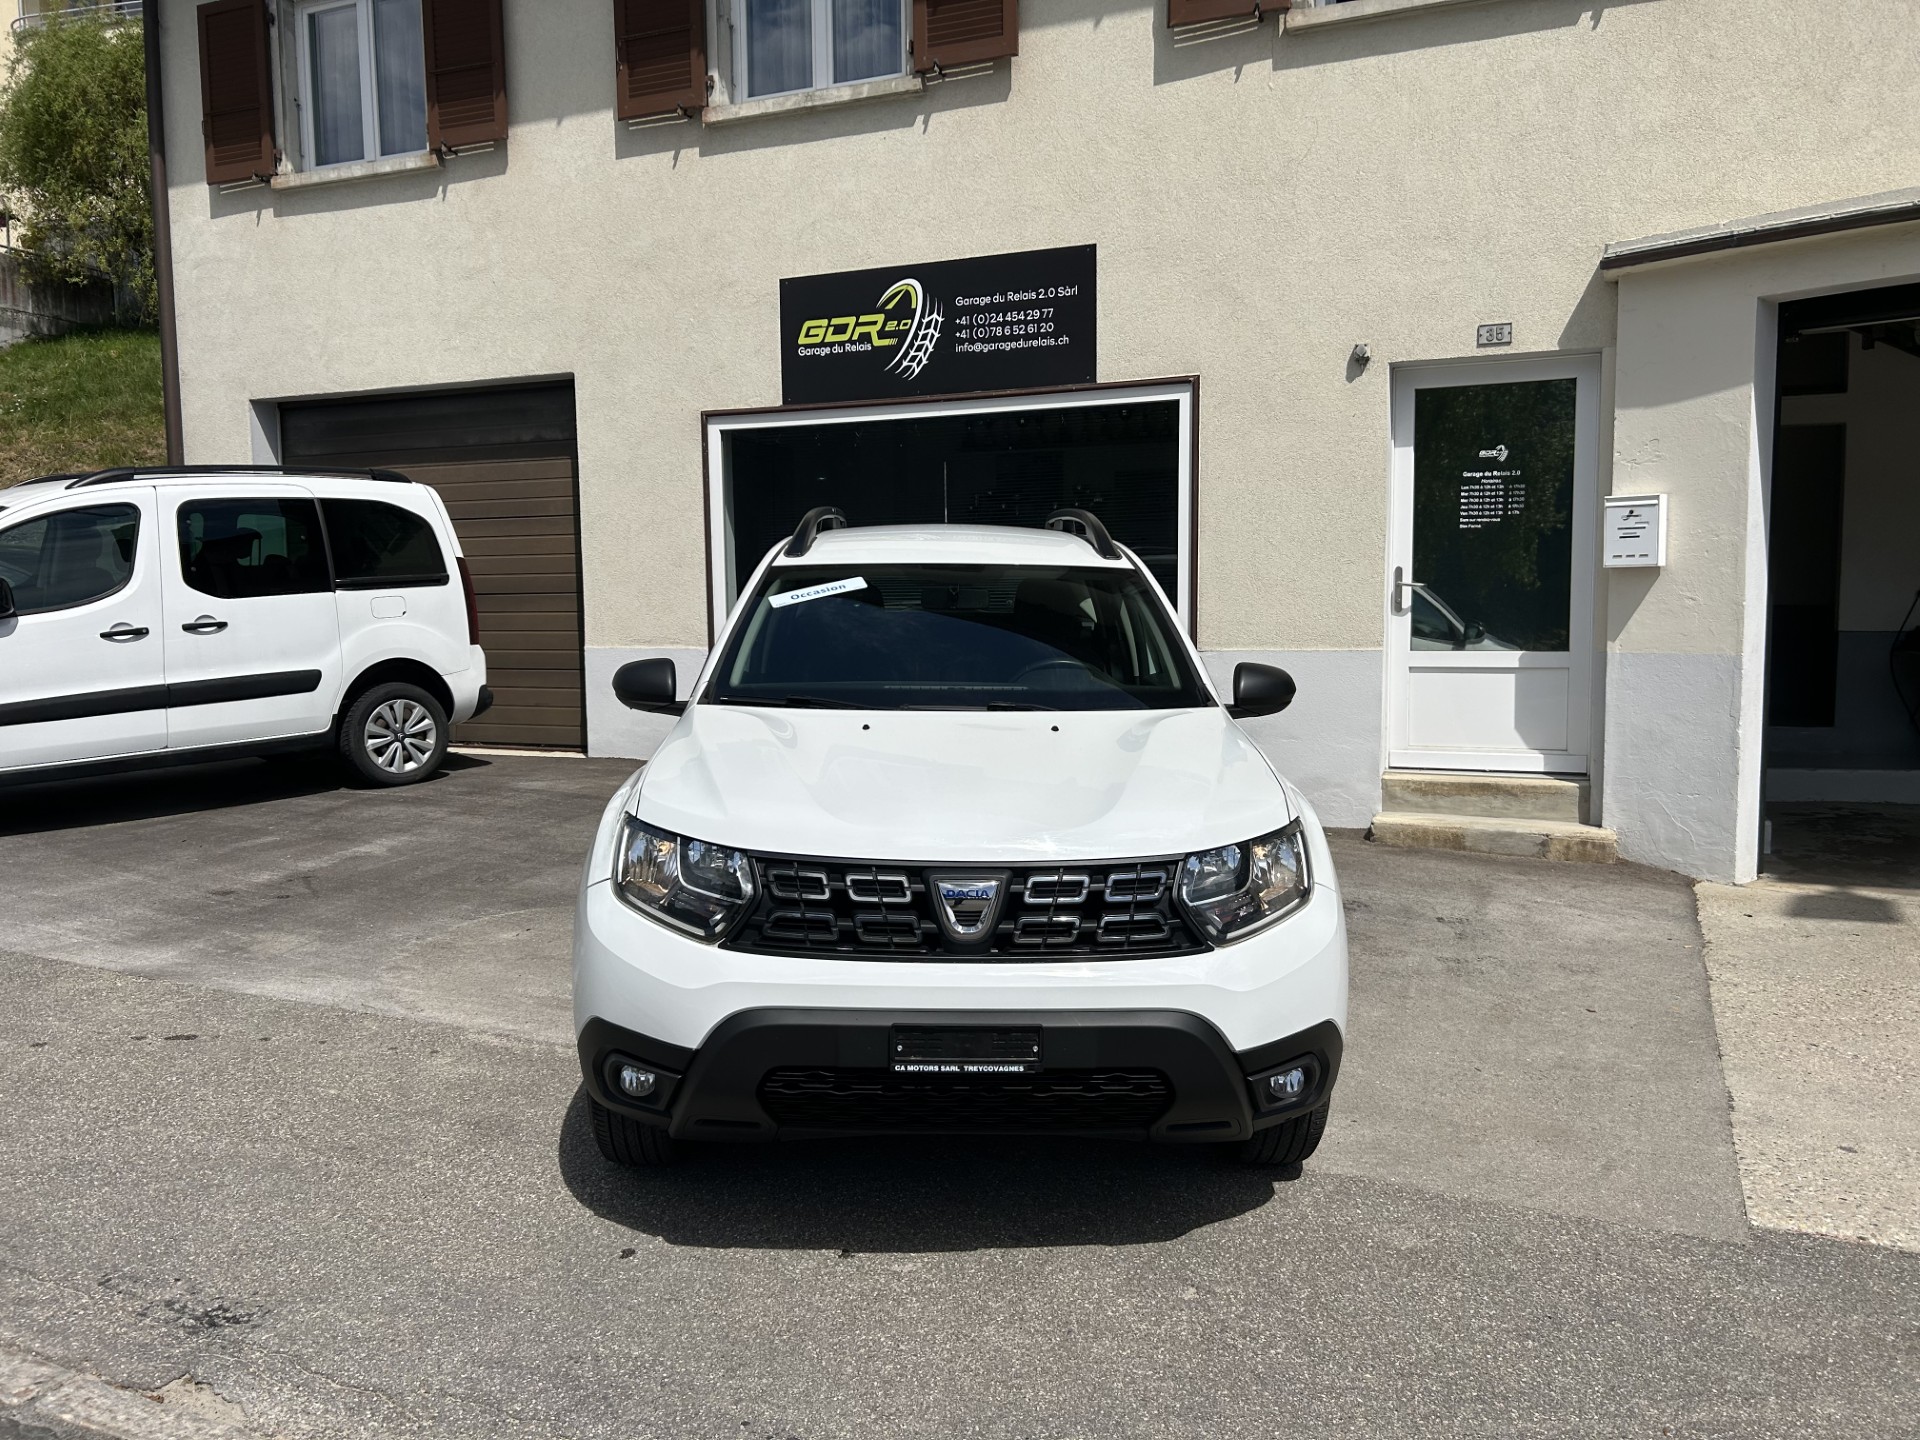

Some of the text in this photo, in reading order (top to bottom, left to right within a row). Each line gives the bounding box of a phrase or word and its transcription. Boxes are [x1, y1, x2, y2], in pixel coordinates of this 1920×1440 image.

[955, 296, 991, 306] Garage
[993, 293, 1005, 303] du
[1007, 290, 1037, 301] Relais
[1038, 287, 1056, 299] 2.0
[955, 316, 970, 325] +41
[1005, 311, 1025, 321] 454
[1026, 309, 1040, 320] 29
[1042, 308, 1054, 318] 77
[797, 313, 912, 346] GDR 2.0
[955, 329, 970, 339] +41
[1004, 326, 1011, 335] 6
[1013, 325, 1026, 335] 52
[1027, 324, 1038, 334] 61
[1040, 322, 1054, 332] 20
[1486, 326, 1504, 342] 35
[798, 342, 872, 356] Garage du Relais
[955, 335, 1069, 353] info@garagedurelais.ch
[791, 585, 846, 600] Occasion
